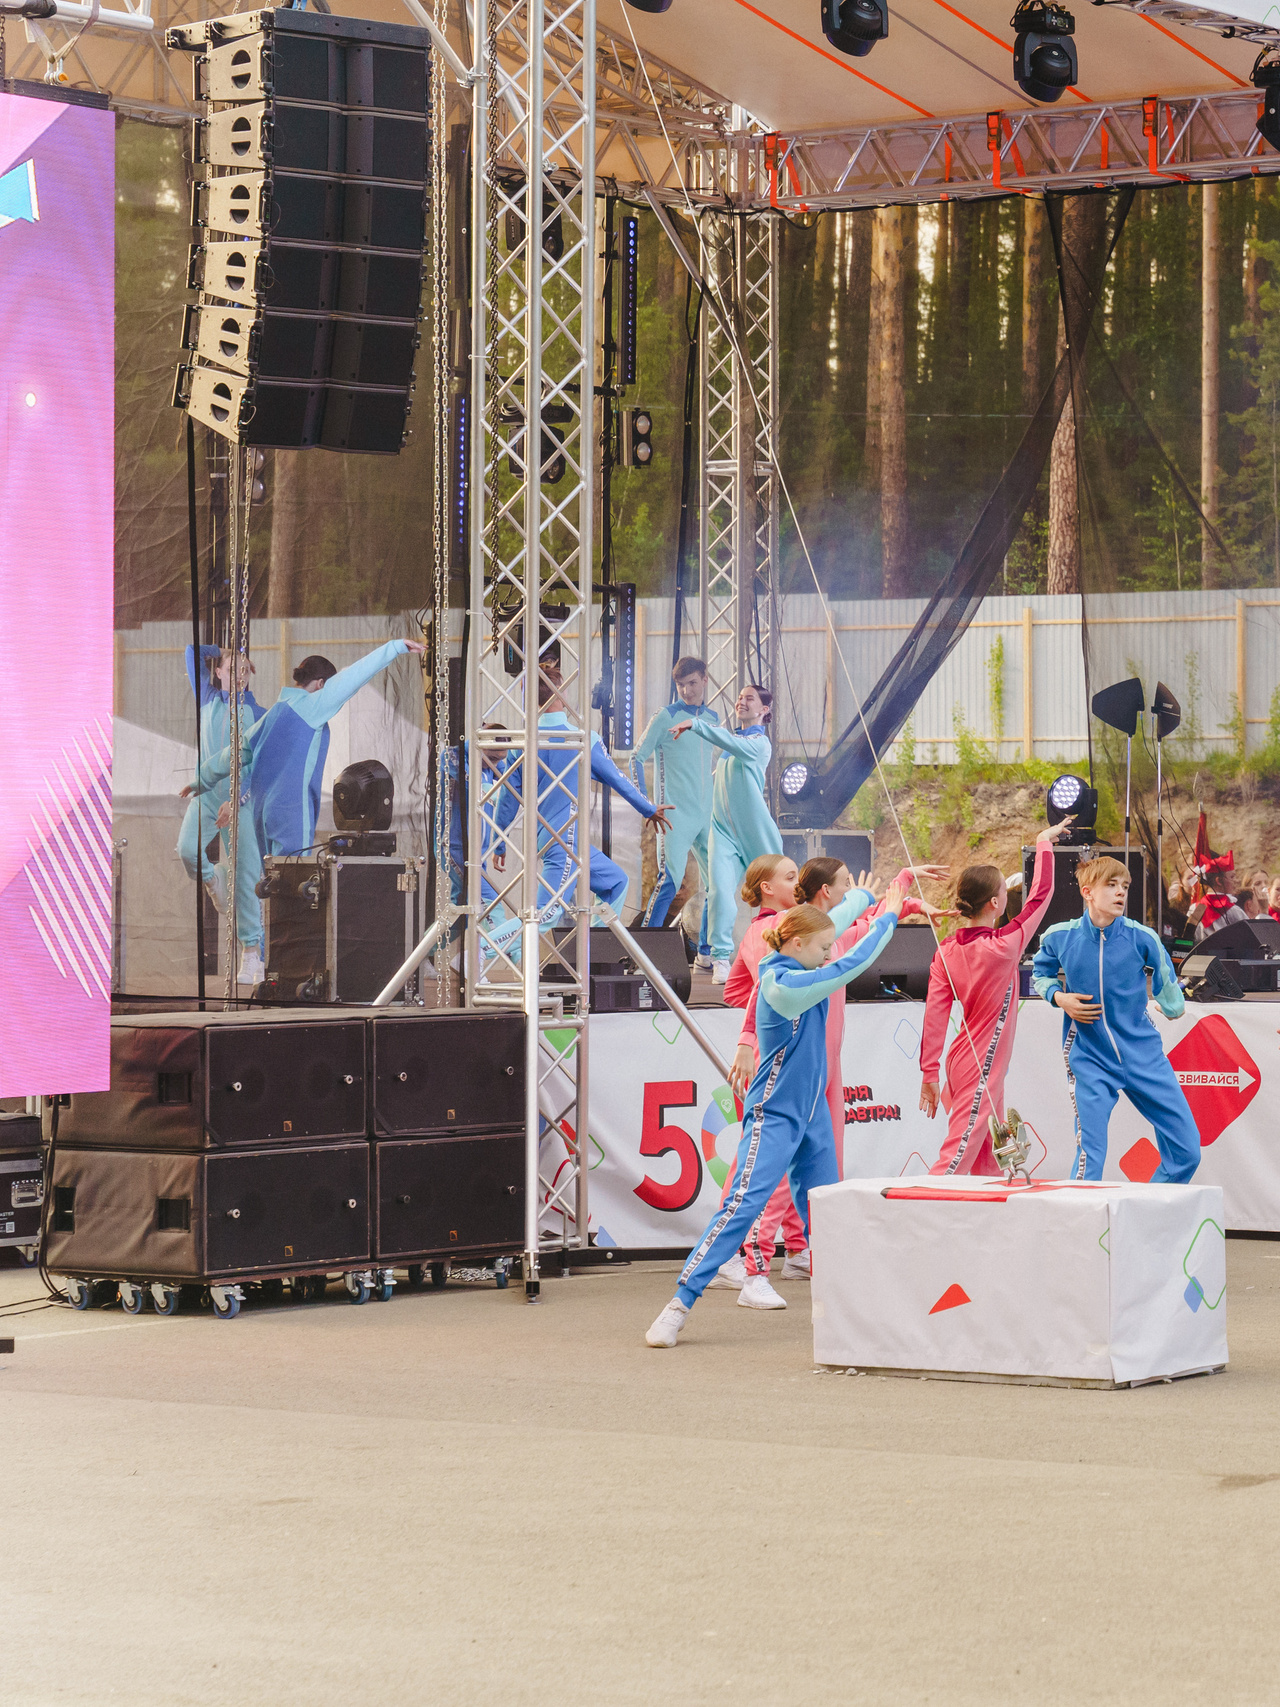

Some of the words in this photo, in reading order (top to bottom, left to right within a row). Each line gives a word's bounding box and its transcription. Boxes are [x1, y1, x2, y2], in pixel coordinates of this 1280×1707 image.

[845, 1104, 901, 1124] АВТРА!
[949, 1145, 966, 1171] BALLET
[971, 1087, 983, 1114] BALLET
[988, 1026, 1002, 1055] BALLET
[682, 1252, 703, 1278] BALLET
[705, 1217, 728, 1247] APELSIN
[741, 1155, 755, 1189] APELSIN
[749, 1127, 760, 1156] BALLET
